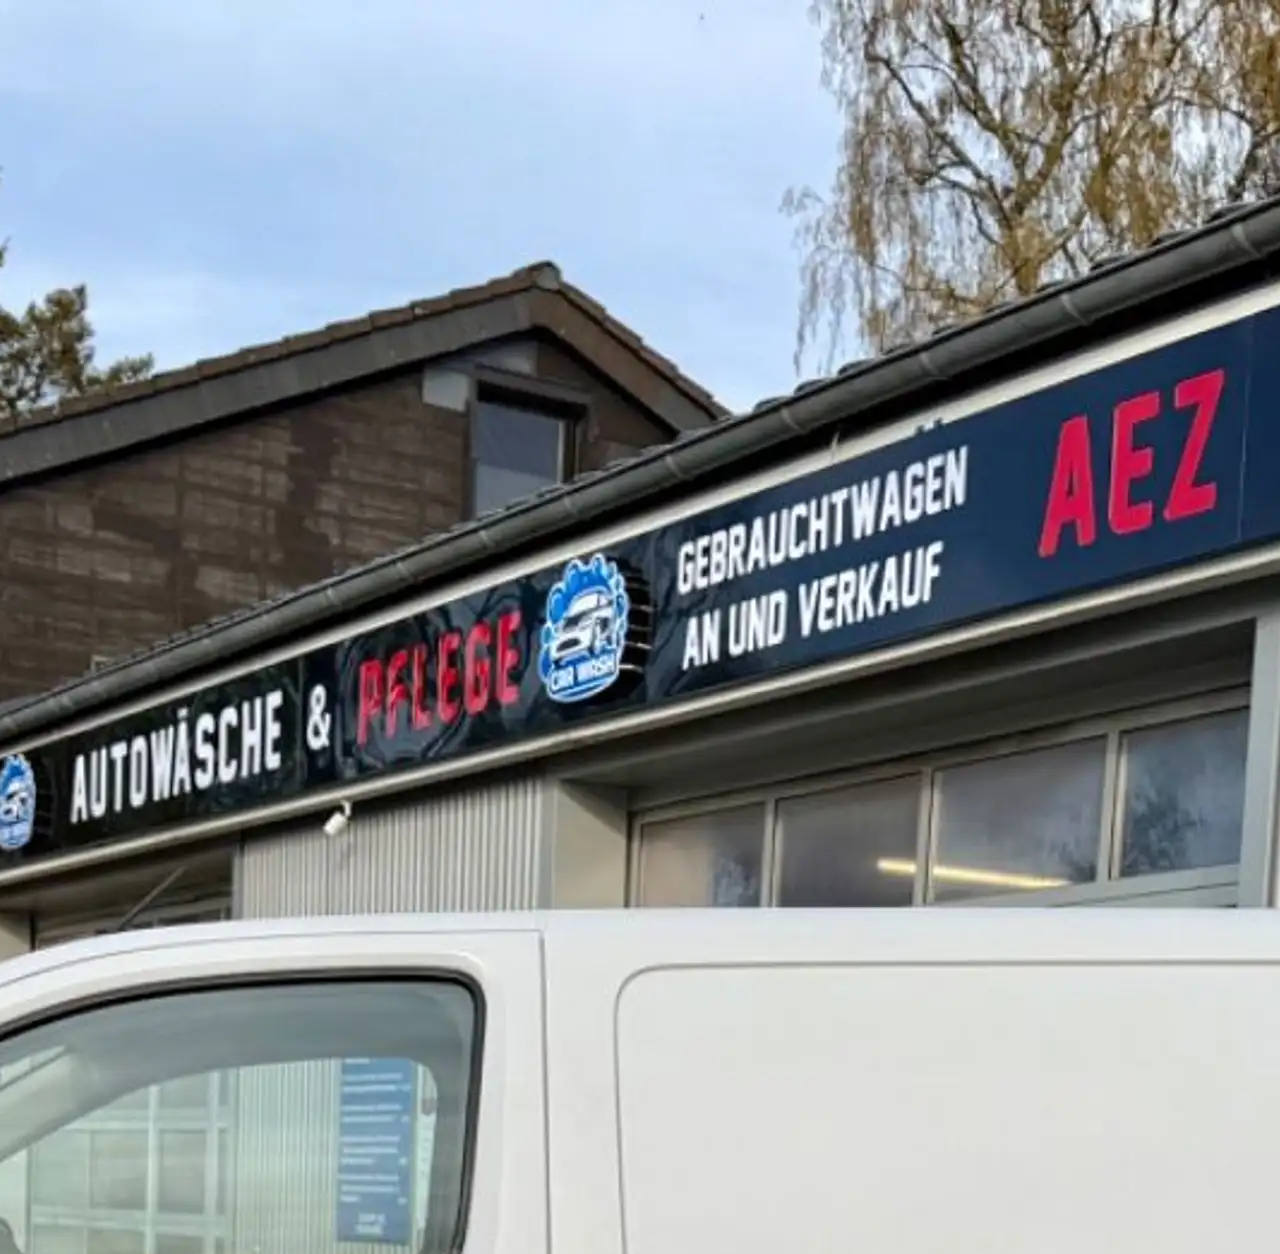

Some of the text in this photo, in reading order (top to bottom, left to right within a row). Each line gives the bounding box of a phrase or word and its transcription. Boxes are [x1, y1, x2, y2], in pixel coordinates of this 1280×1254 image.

[676, 445, 968, 596] GEBRAUCHTWAGEN
[1040, 367, 1225, 557] AEZ
[682, 541, 945, 671] AN UND VERKAUF
[70, 610, 523, 824] AUTOWÄSCHE & PFLEGE
